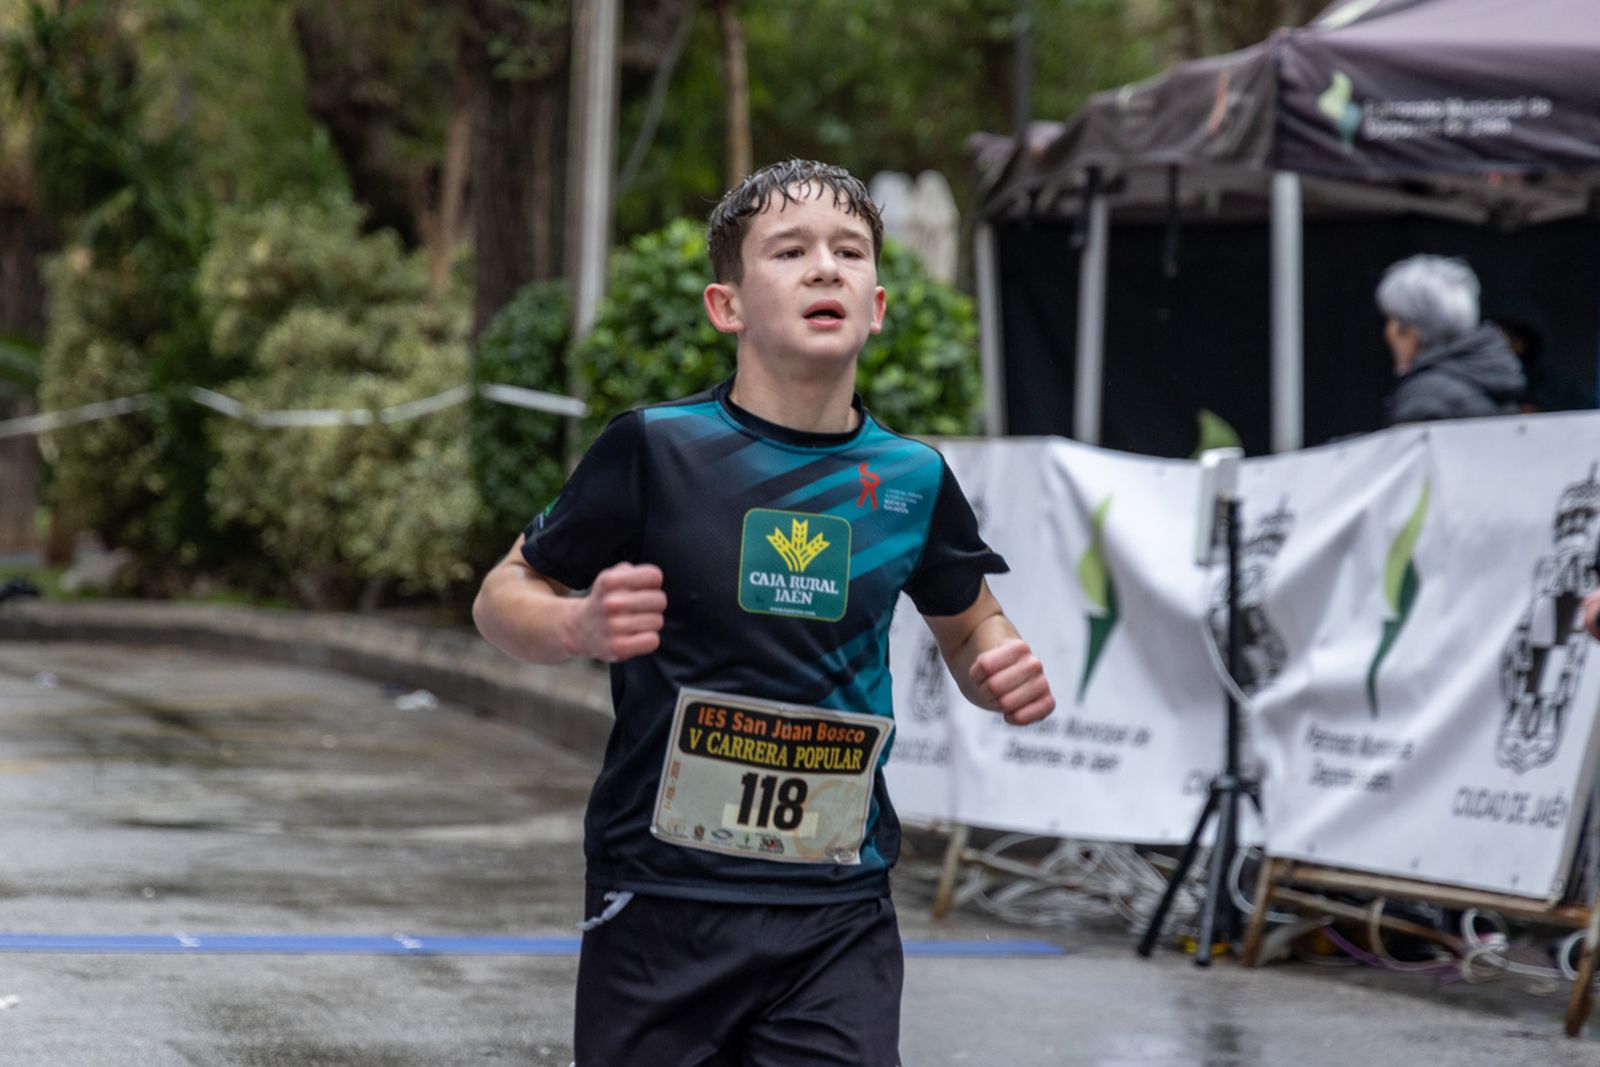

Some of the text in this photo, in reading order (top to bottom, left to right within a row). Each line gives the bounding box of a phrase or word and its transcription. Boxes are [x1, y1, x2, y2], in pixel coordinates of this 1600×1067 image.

[749, 571, 839, 595] CAJA RURAL
[774, 588, 813, 605] JAÉN
[698, 706, 866, 744] IES San Juan Bosco
[689, 728, 864, 770] V CARRERA POPULAR
[736, 772, 808, 831] 118
[1453, 787, 1504, 820] CIUDAD
[1505, 793, 1530, 823] DE
